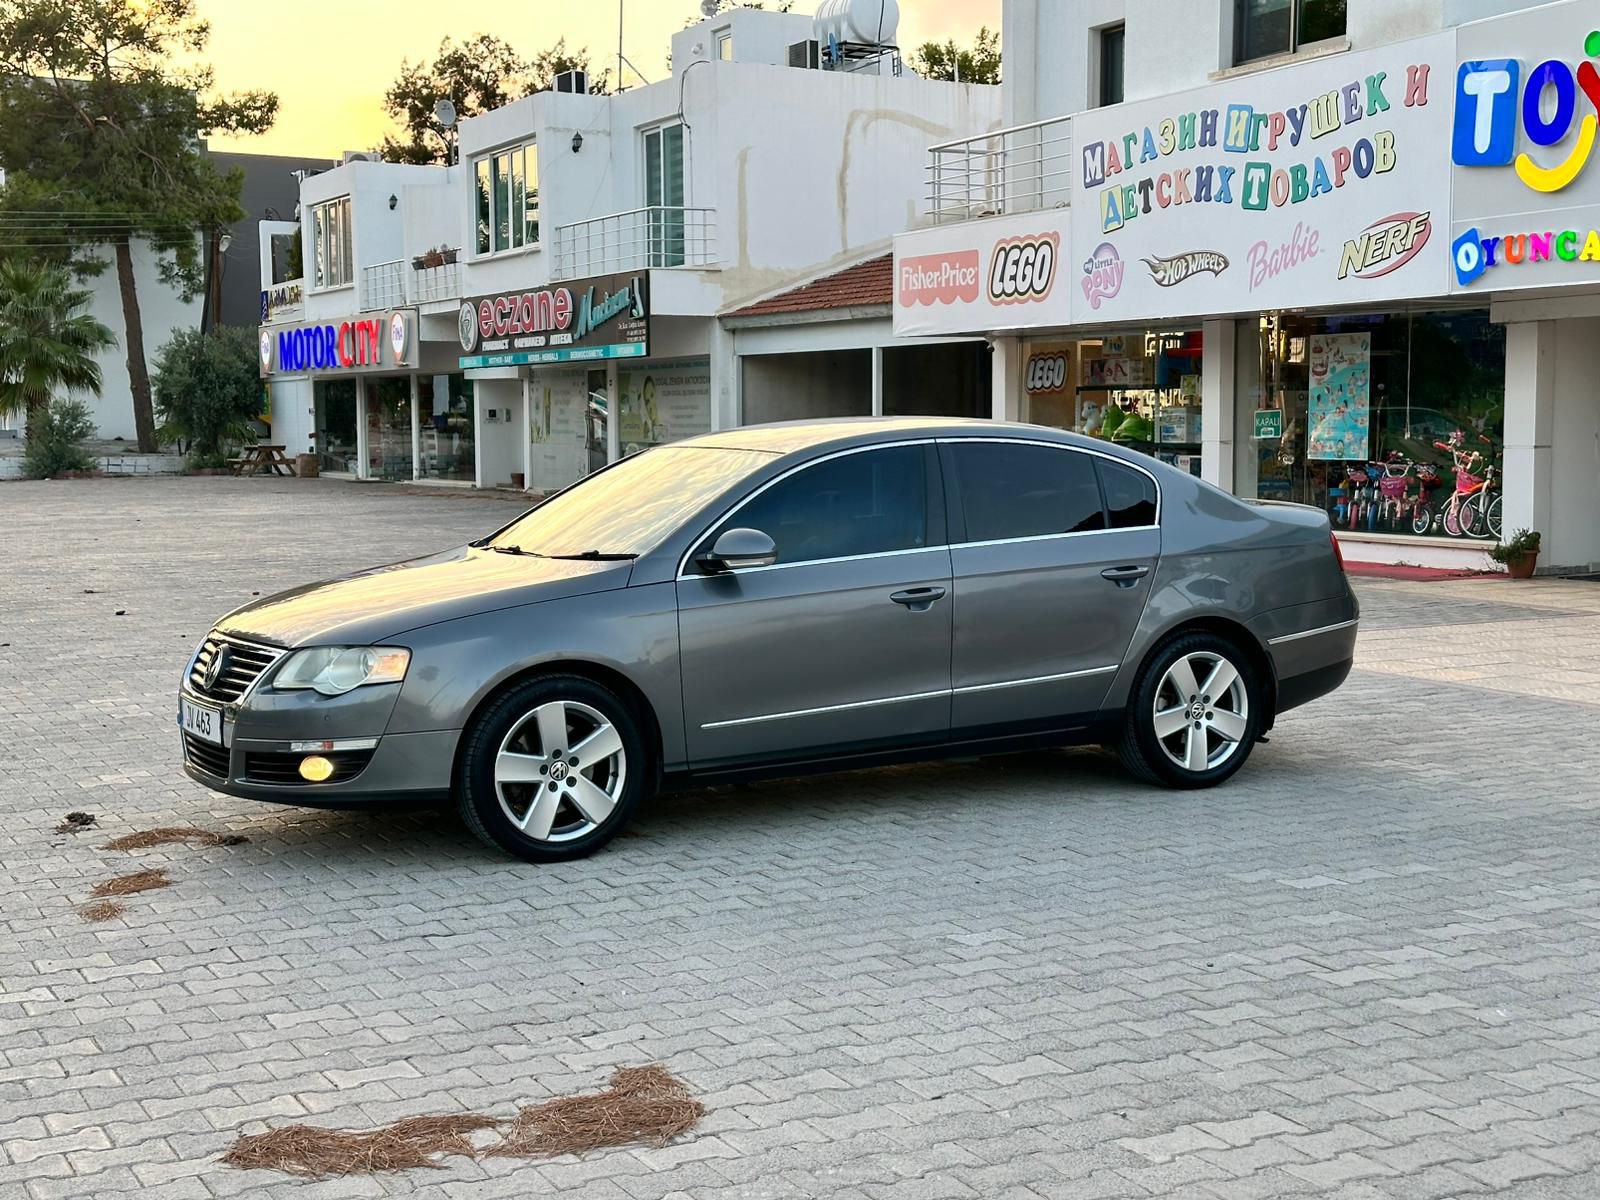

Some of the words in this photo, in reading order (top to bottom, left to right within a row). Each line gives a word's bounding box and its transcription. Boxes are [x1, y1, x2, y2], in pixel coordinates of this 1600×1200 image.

[1083, 109, 1219, 189] МАГАЗИН
[1224, 71, 1391, 154] ИГРУШЕК
[1404, 63, 1431, 108] И
[1100, 164, 1236, 234] ДЕТСКИХ
[1241, 130, 1397, 211] ТОВАРОВ
[991, 241, 1053, 298] LEGO
[1247, 221, 1320, 293] Barbie
[1337, 211, 1431, 280] NERF
[1452, 228, 1600, 287] OYUNCA
[902, 261, 977, 292] Fisher-Price
[1081, 260, 1124, 310] PONY
[478, 287, 572, 337] eczane
[279, 325, 337, 371] MOTOR
[339, 319, 384, 367] CITY
[1027, 358, 1066, 391] LEGO
[1256, 416, 1280, 426] KAPALI
[196, 709, 210, 735] 463
